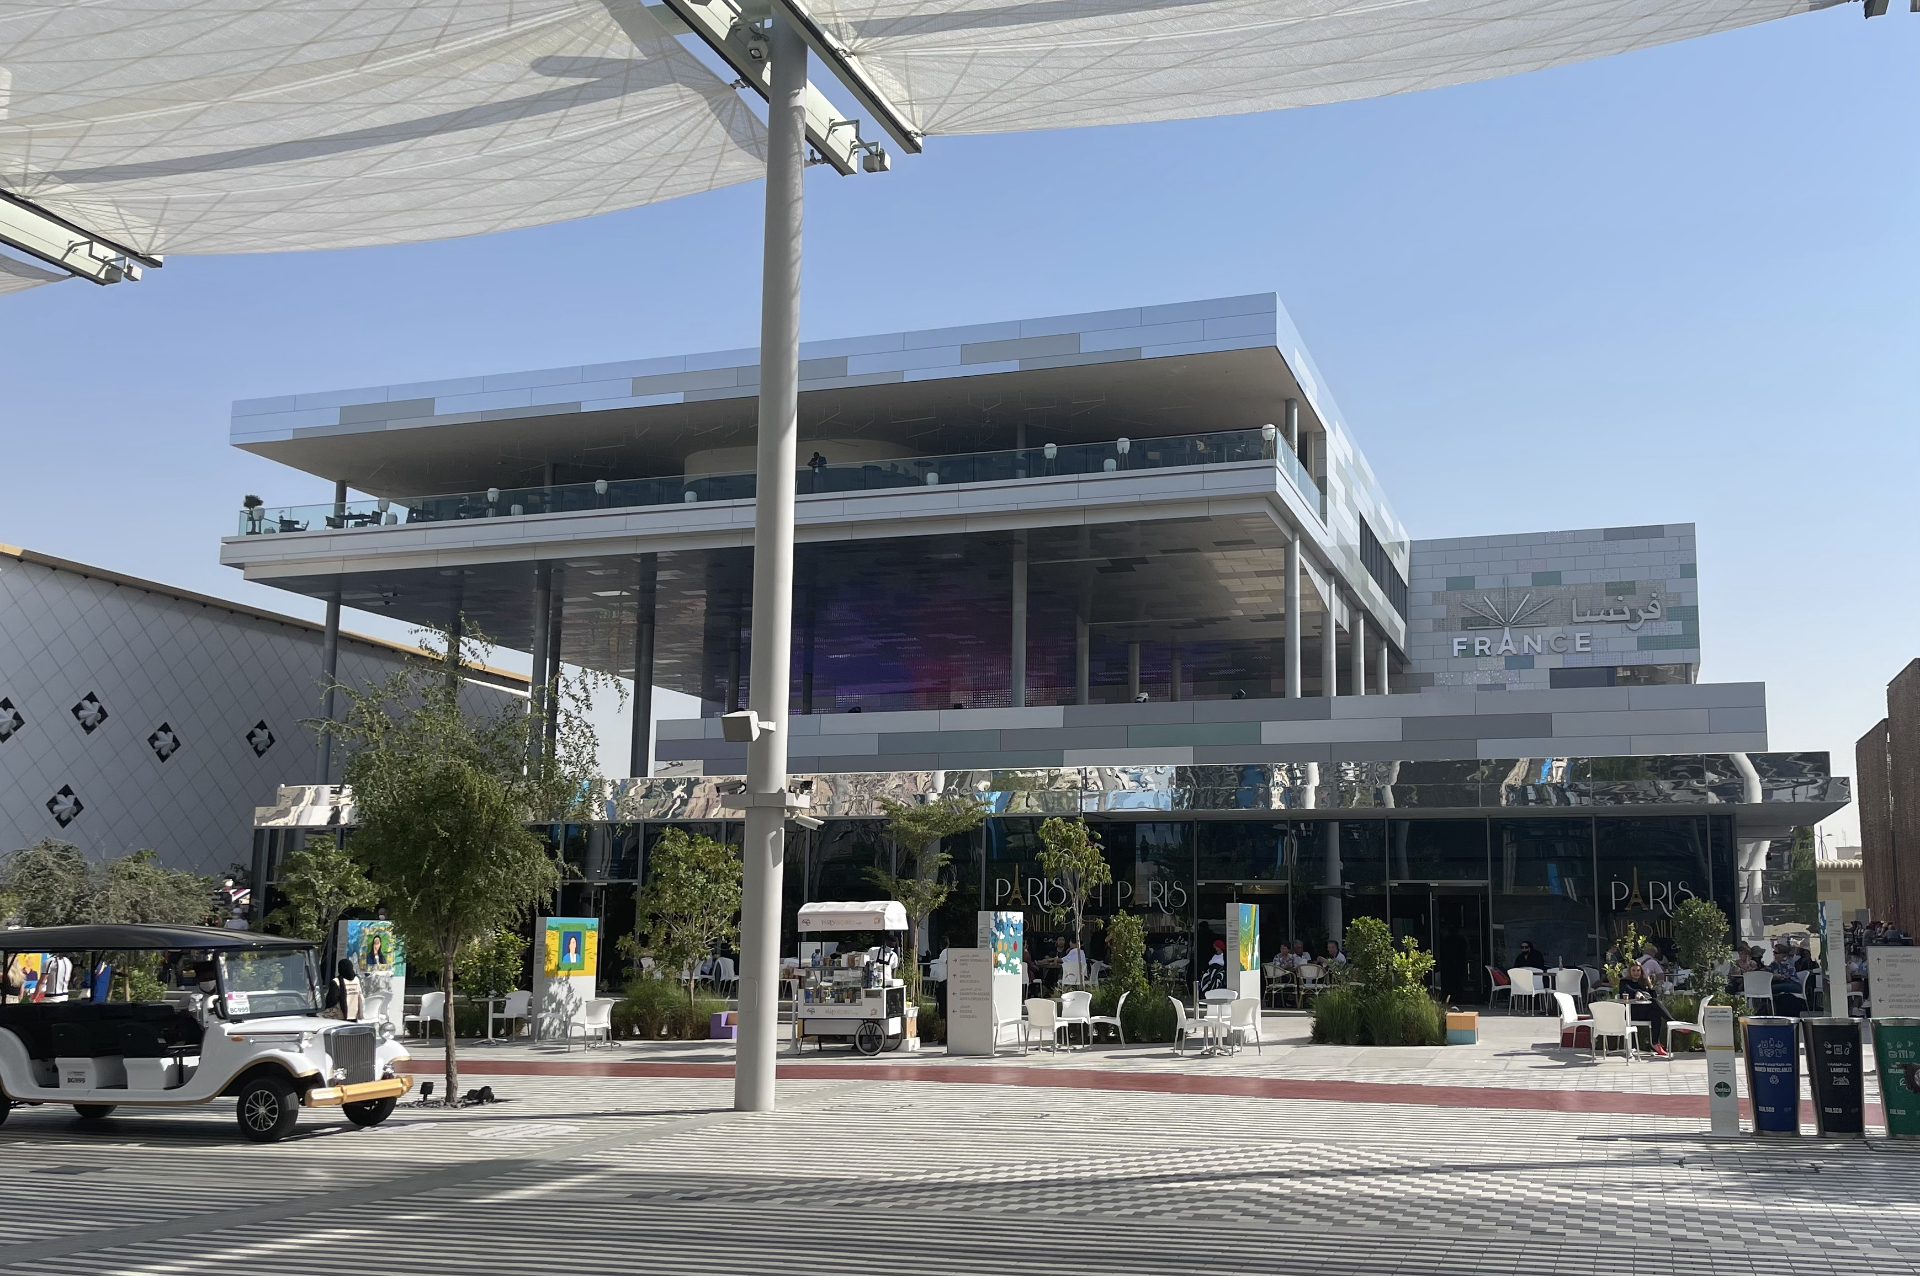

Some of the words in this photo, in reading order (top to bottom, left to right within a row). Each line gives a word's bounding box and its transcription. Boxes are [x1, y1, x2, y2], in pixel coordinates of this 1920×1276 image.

[1571, 592, 1662, 631] فرنسا
[1452, 627, 1592, 657] FRANCE
[995, 863, 1067, 913] PARIS
[1611, 865, 1695, 918] PARIS
